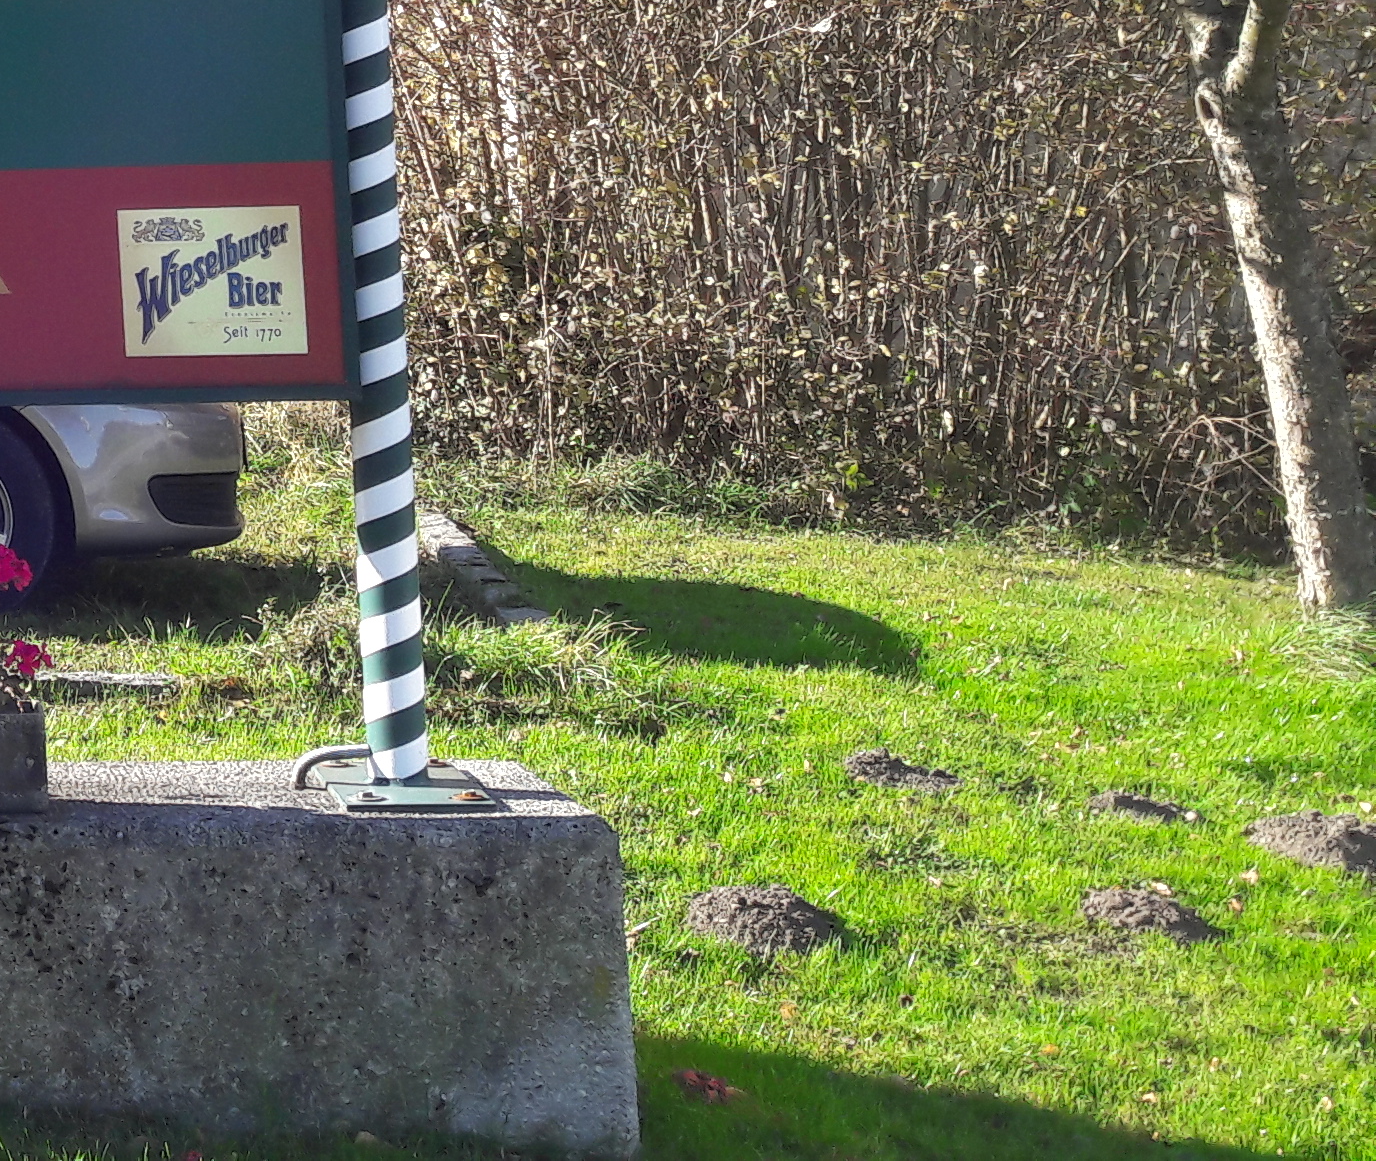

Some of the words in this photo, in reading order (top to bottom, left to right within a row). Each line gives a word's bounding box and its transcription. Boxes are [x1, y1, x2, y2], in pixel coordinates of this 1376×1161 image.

[134, 222, 289, 346] Wieselburger
[227, 272, 283, 309] Bier
[223, 326, 249, 344] Seit
[255, 328, 282, 342] 1770
